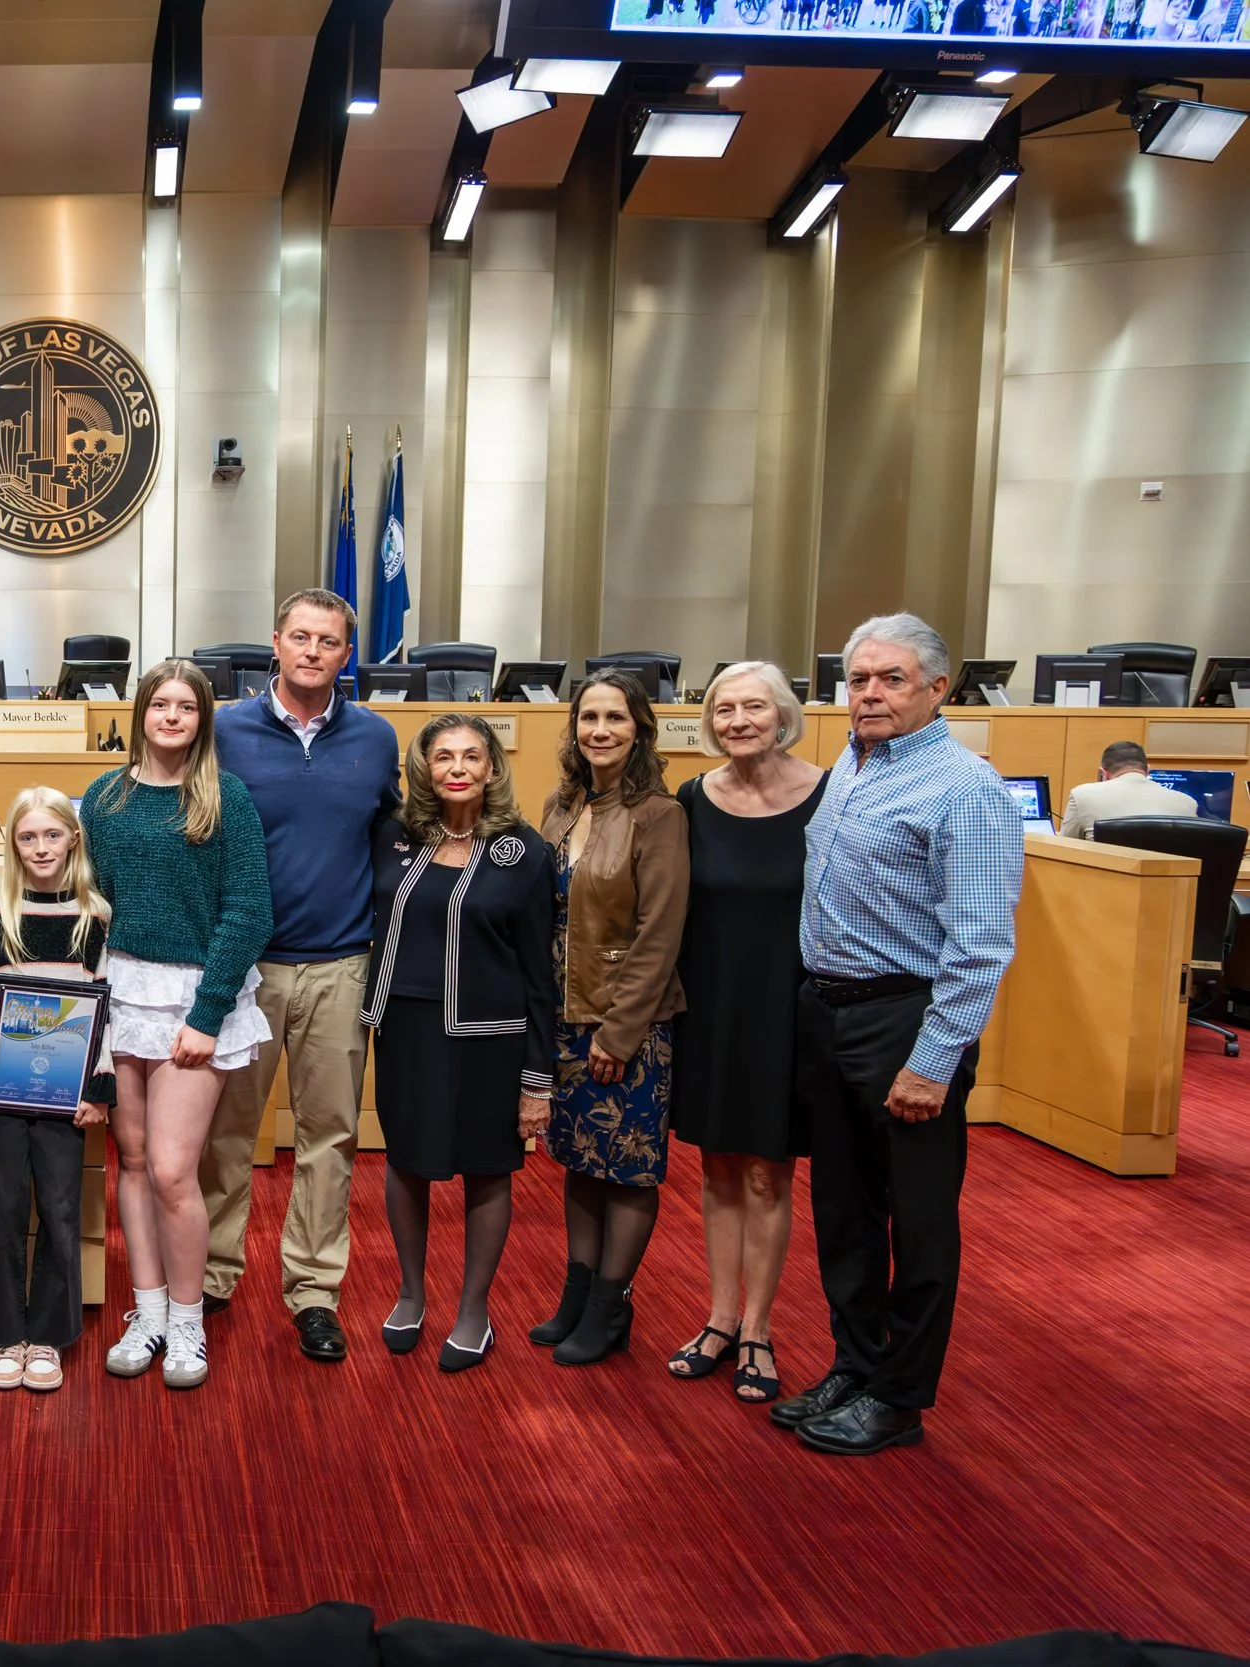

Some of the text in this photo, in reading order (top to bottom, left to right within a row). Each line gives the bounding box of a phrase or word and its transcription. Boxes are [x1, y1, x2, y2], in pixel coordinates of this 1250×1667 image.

[937, 50, 986, 61] Panasonic
[25, 329, 82, 351] LAS
[86, 339, 152, 429] VEGAS
[2, 712, 68, 723] Mayor Berkley
[6, 998, 53, 1019] Citizen
